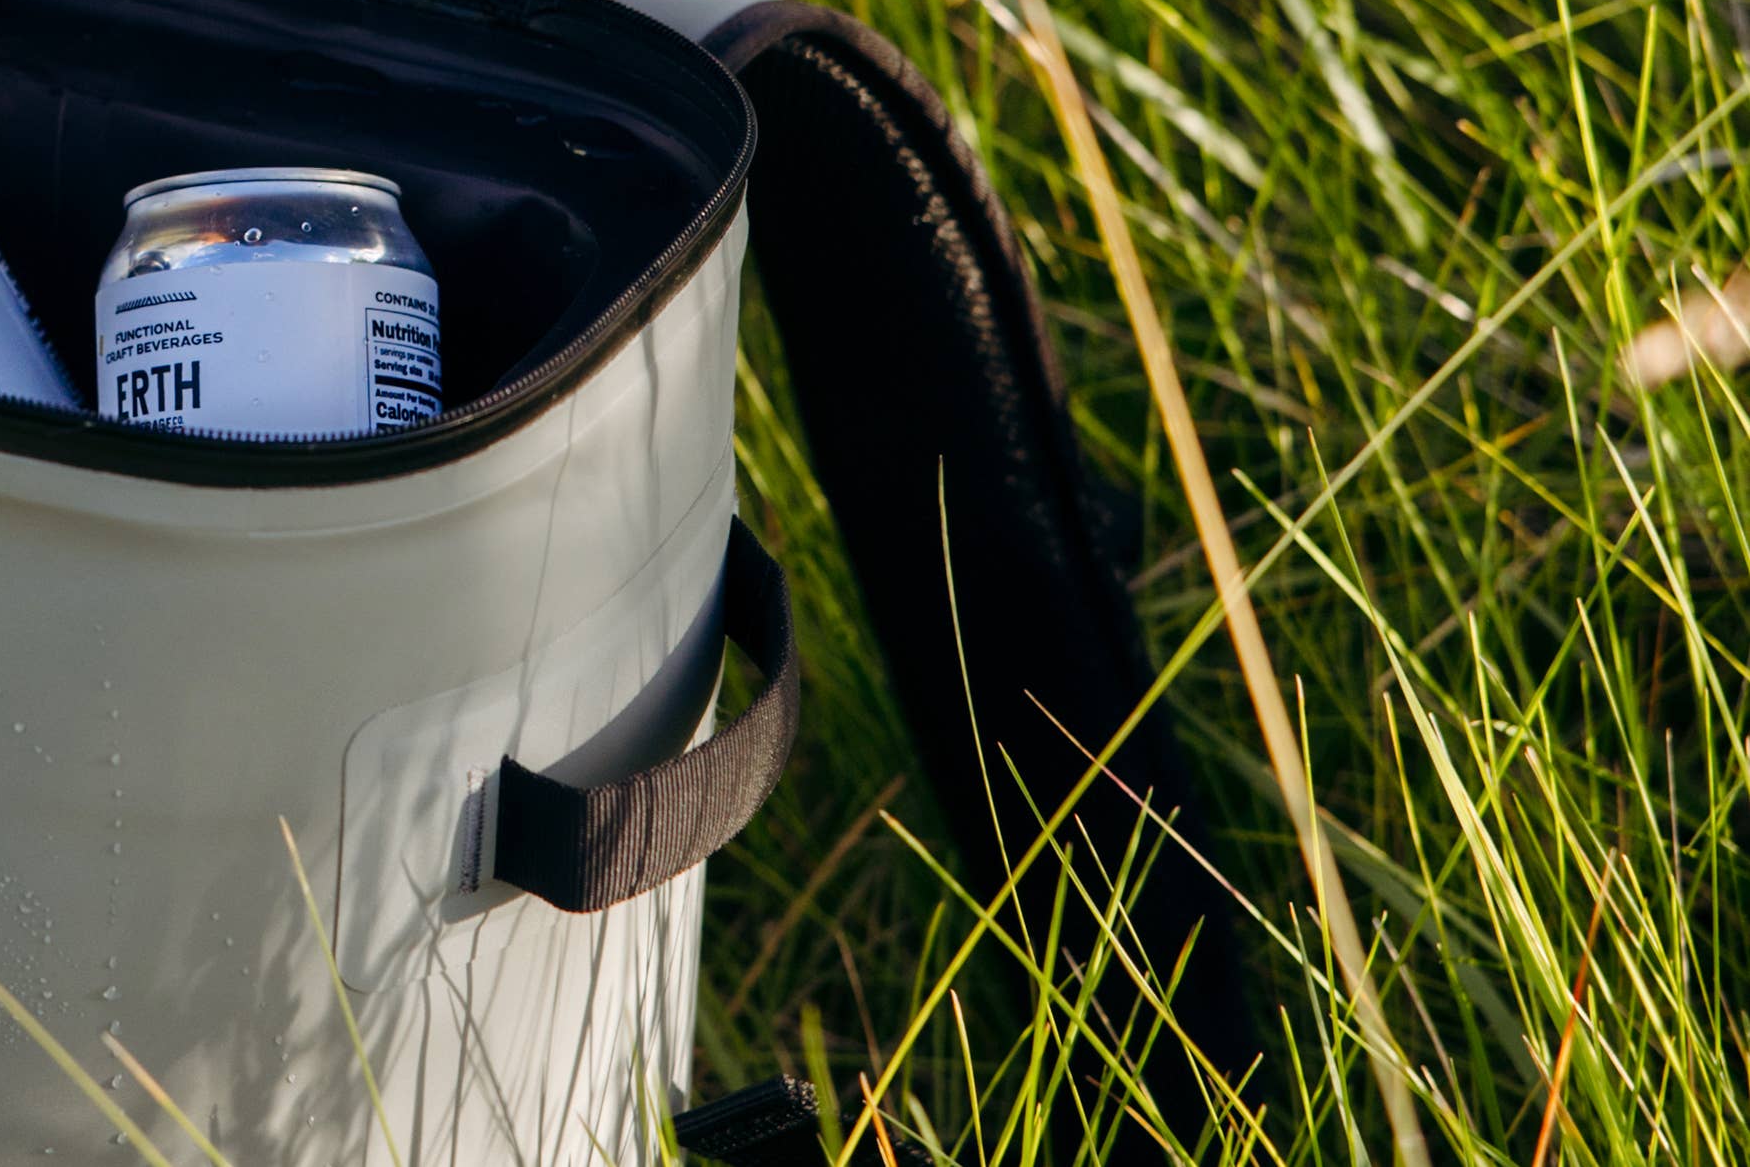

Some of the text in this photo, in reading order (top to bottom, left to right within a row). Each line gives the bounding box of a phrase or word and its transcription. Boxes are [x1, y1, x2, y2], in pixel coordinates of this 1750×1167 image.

[375, 291, 428, 313] CONTAINS
[115, 320, 194, 345] FUNCTIONAL
[372, 319, 431, 349] Nutrition
[106, 332, 223, 365] CRAFT BEVERAGES
[374, 359, 408, 376] Serving
[117, 360, 201, 421] ERTH
[375, 388, 405, 401] Amount
